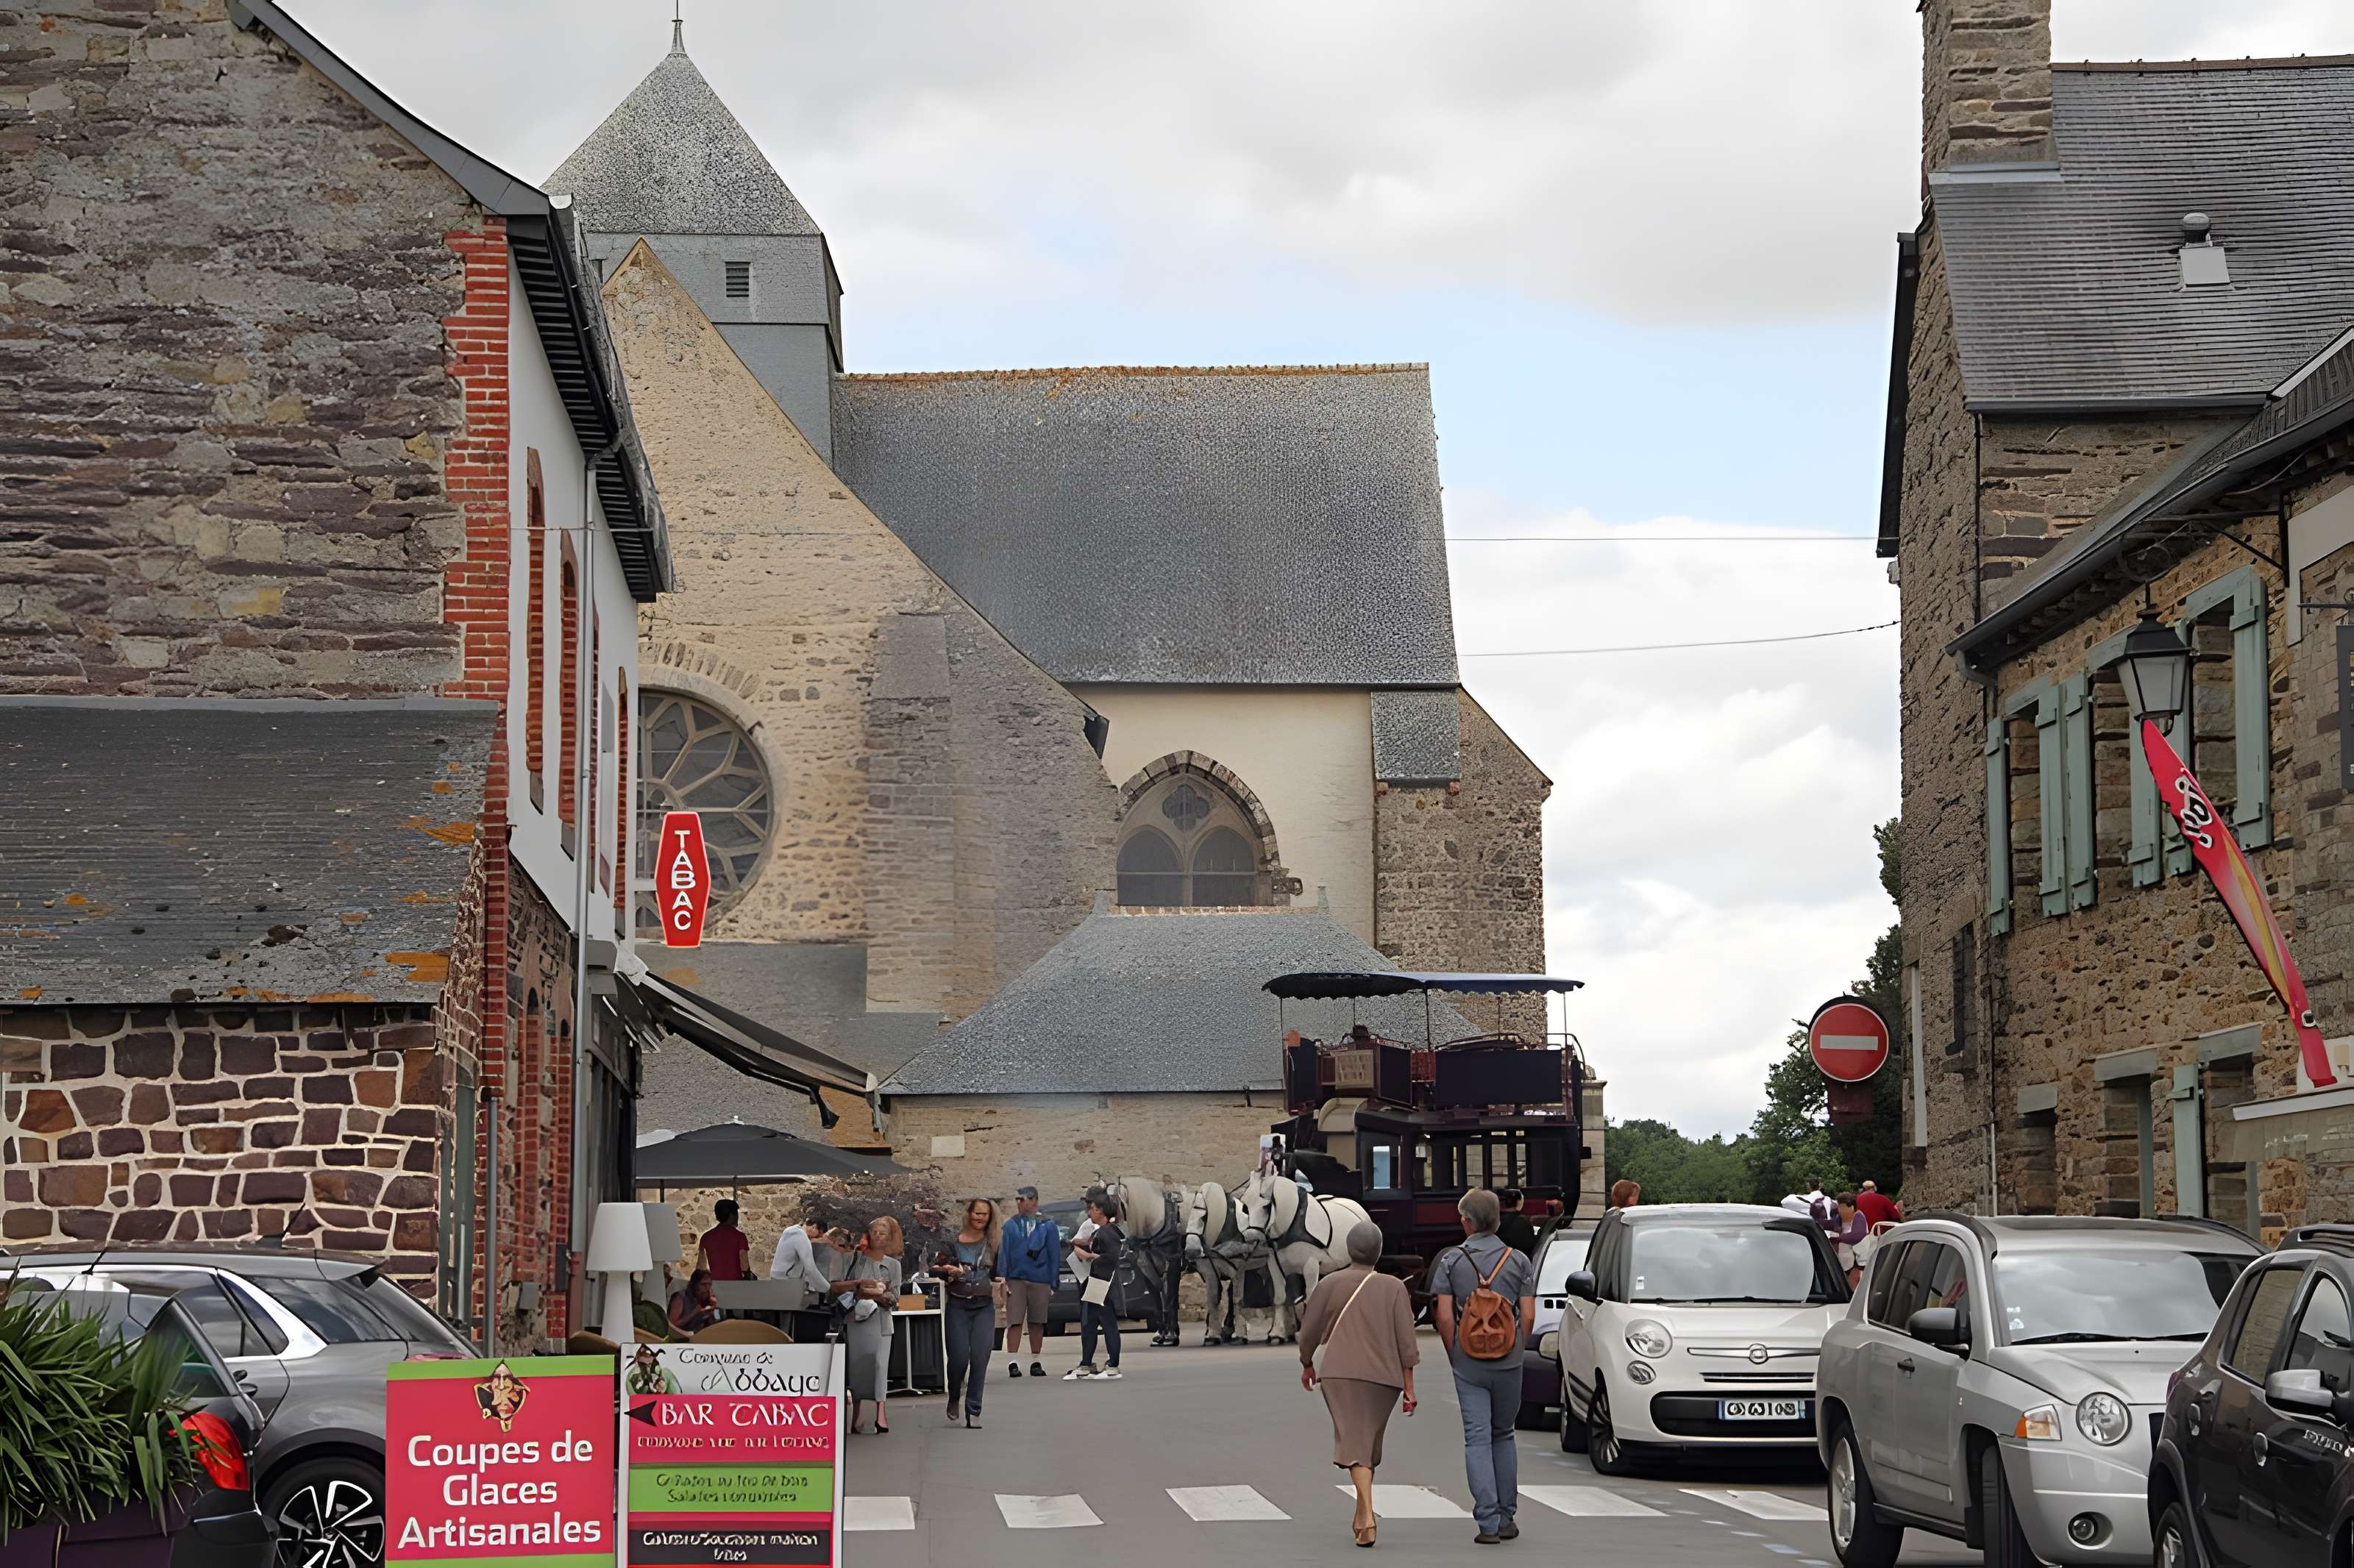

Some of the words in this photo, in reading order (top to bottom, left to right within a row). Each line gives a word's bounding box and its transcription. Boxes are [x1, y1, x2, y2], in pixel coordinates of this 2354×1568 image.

[671, 830, 696, 930] TABAC
[662, 1403, 714, 1425] BAR
[730, 1403, 829, 1427] TABAC
[408, 1435, 540, 1473] Coupes
[552, 1429, 593, 1462] de
[443, 1473, 558, 1506] Glaces
[397, 1511, 601, 1549] Artisanales
